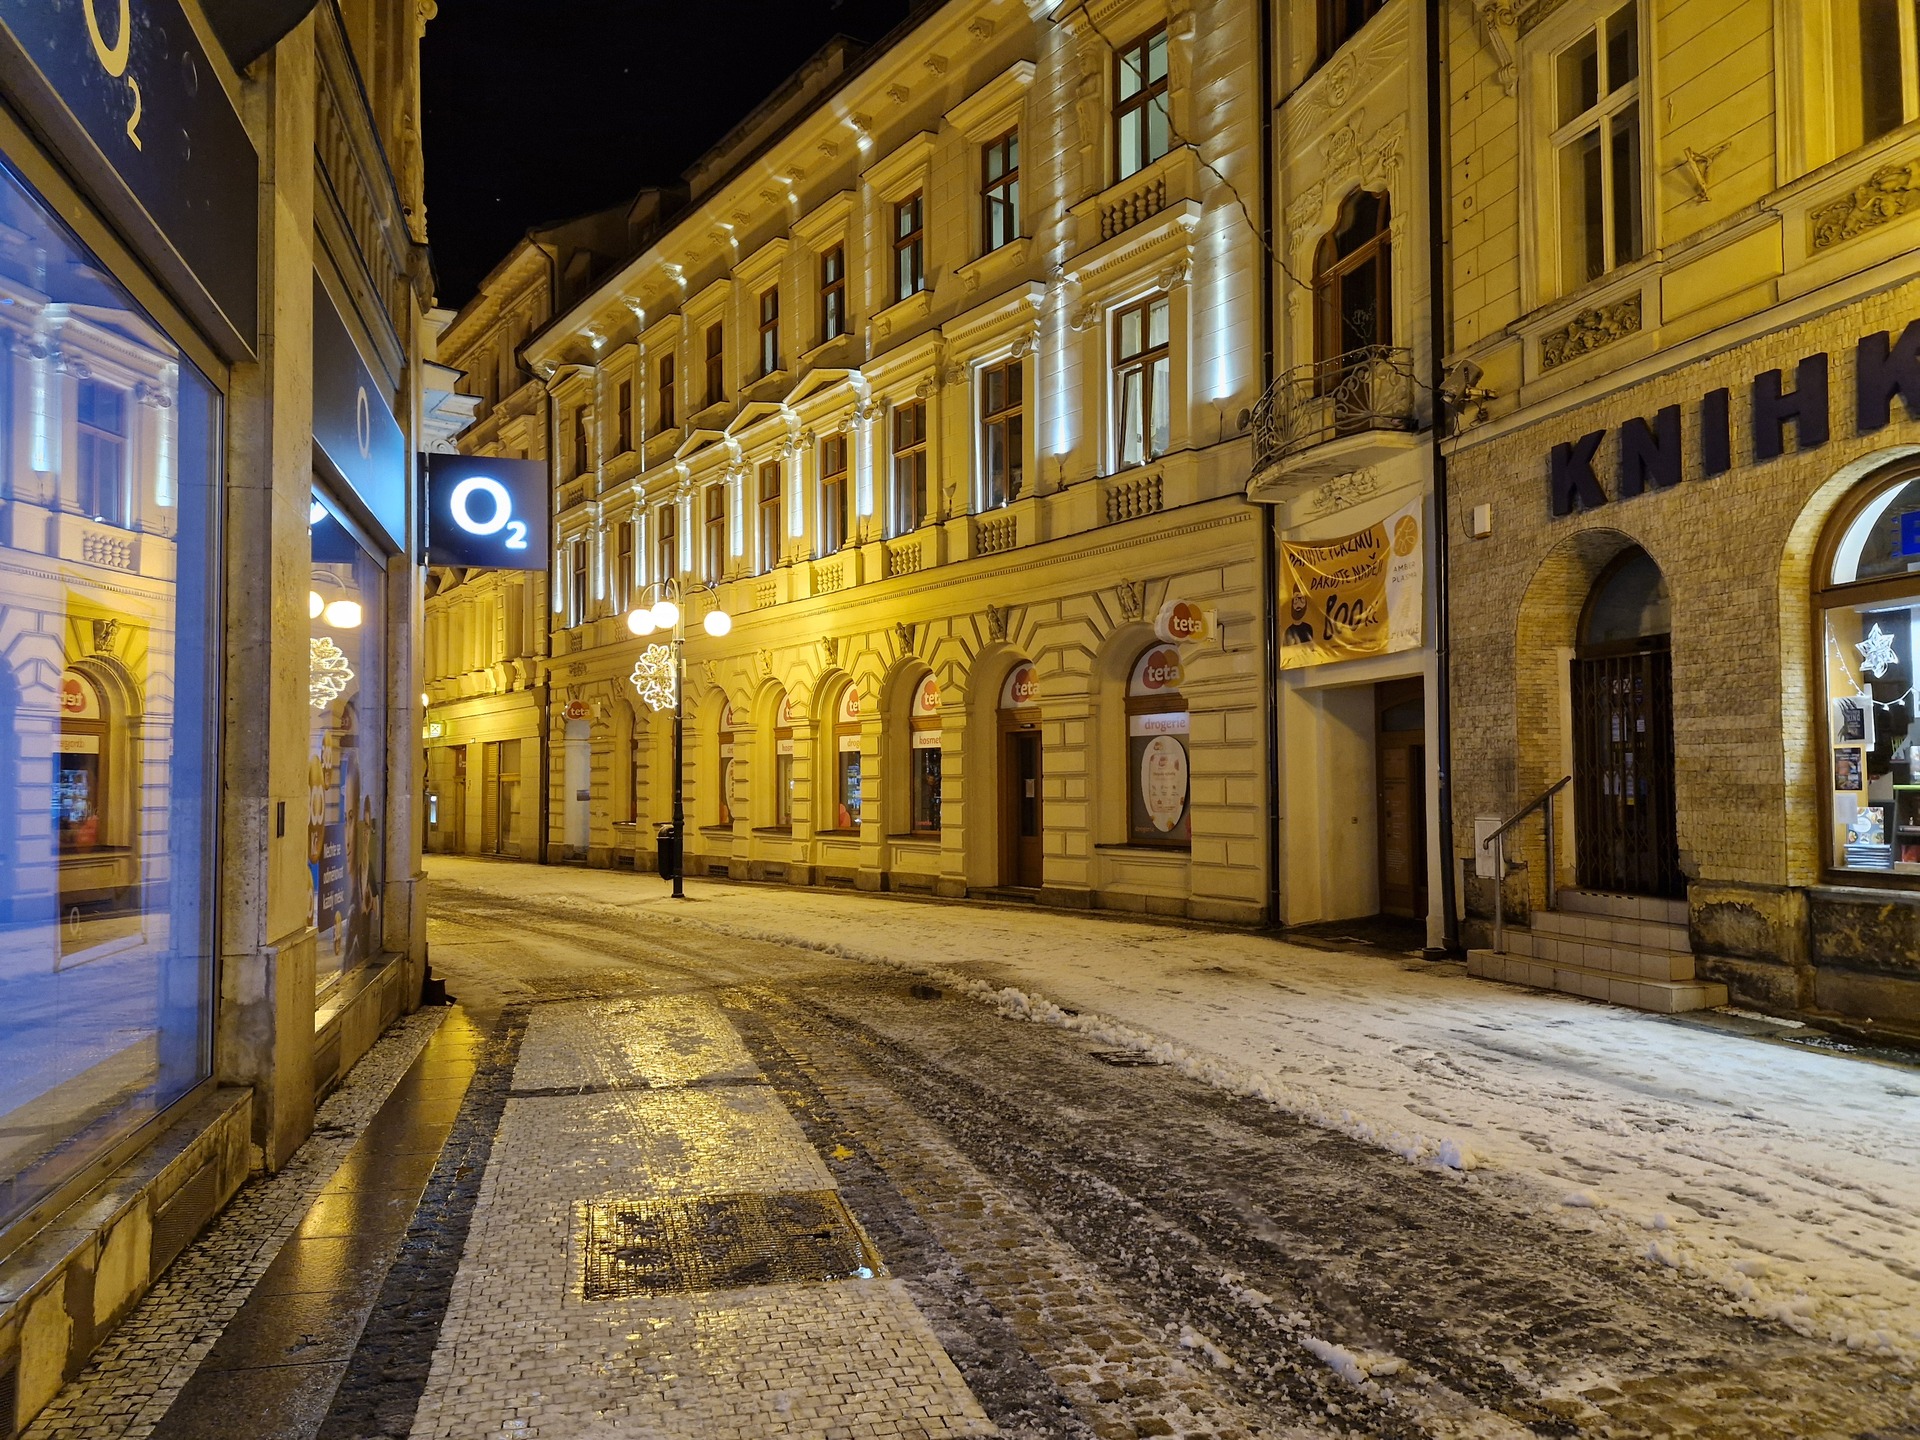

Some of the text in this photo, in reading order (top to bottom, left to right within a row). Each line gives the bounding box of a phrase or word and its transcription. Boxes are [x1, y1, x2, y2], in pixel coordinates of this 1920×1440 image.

[450, 476, 528, 550] O2
[1173, 615, 1202, 633] teta
[1323, 593, 1364, 641] 800
[1147, 664, 1180, 682] teta
[924, 690, 942, 706] tet
[570, 706, 591, 717] teta
[1144, 717, 1186, 732] drogerie
